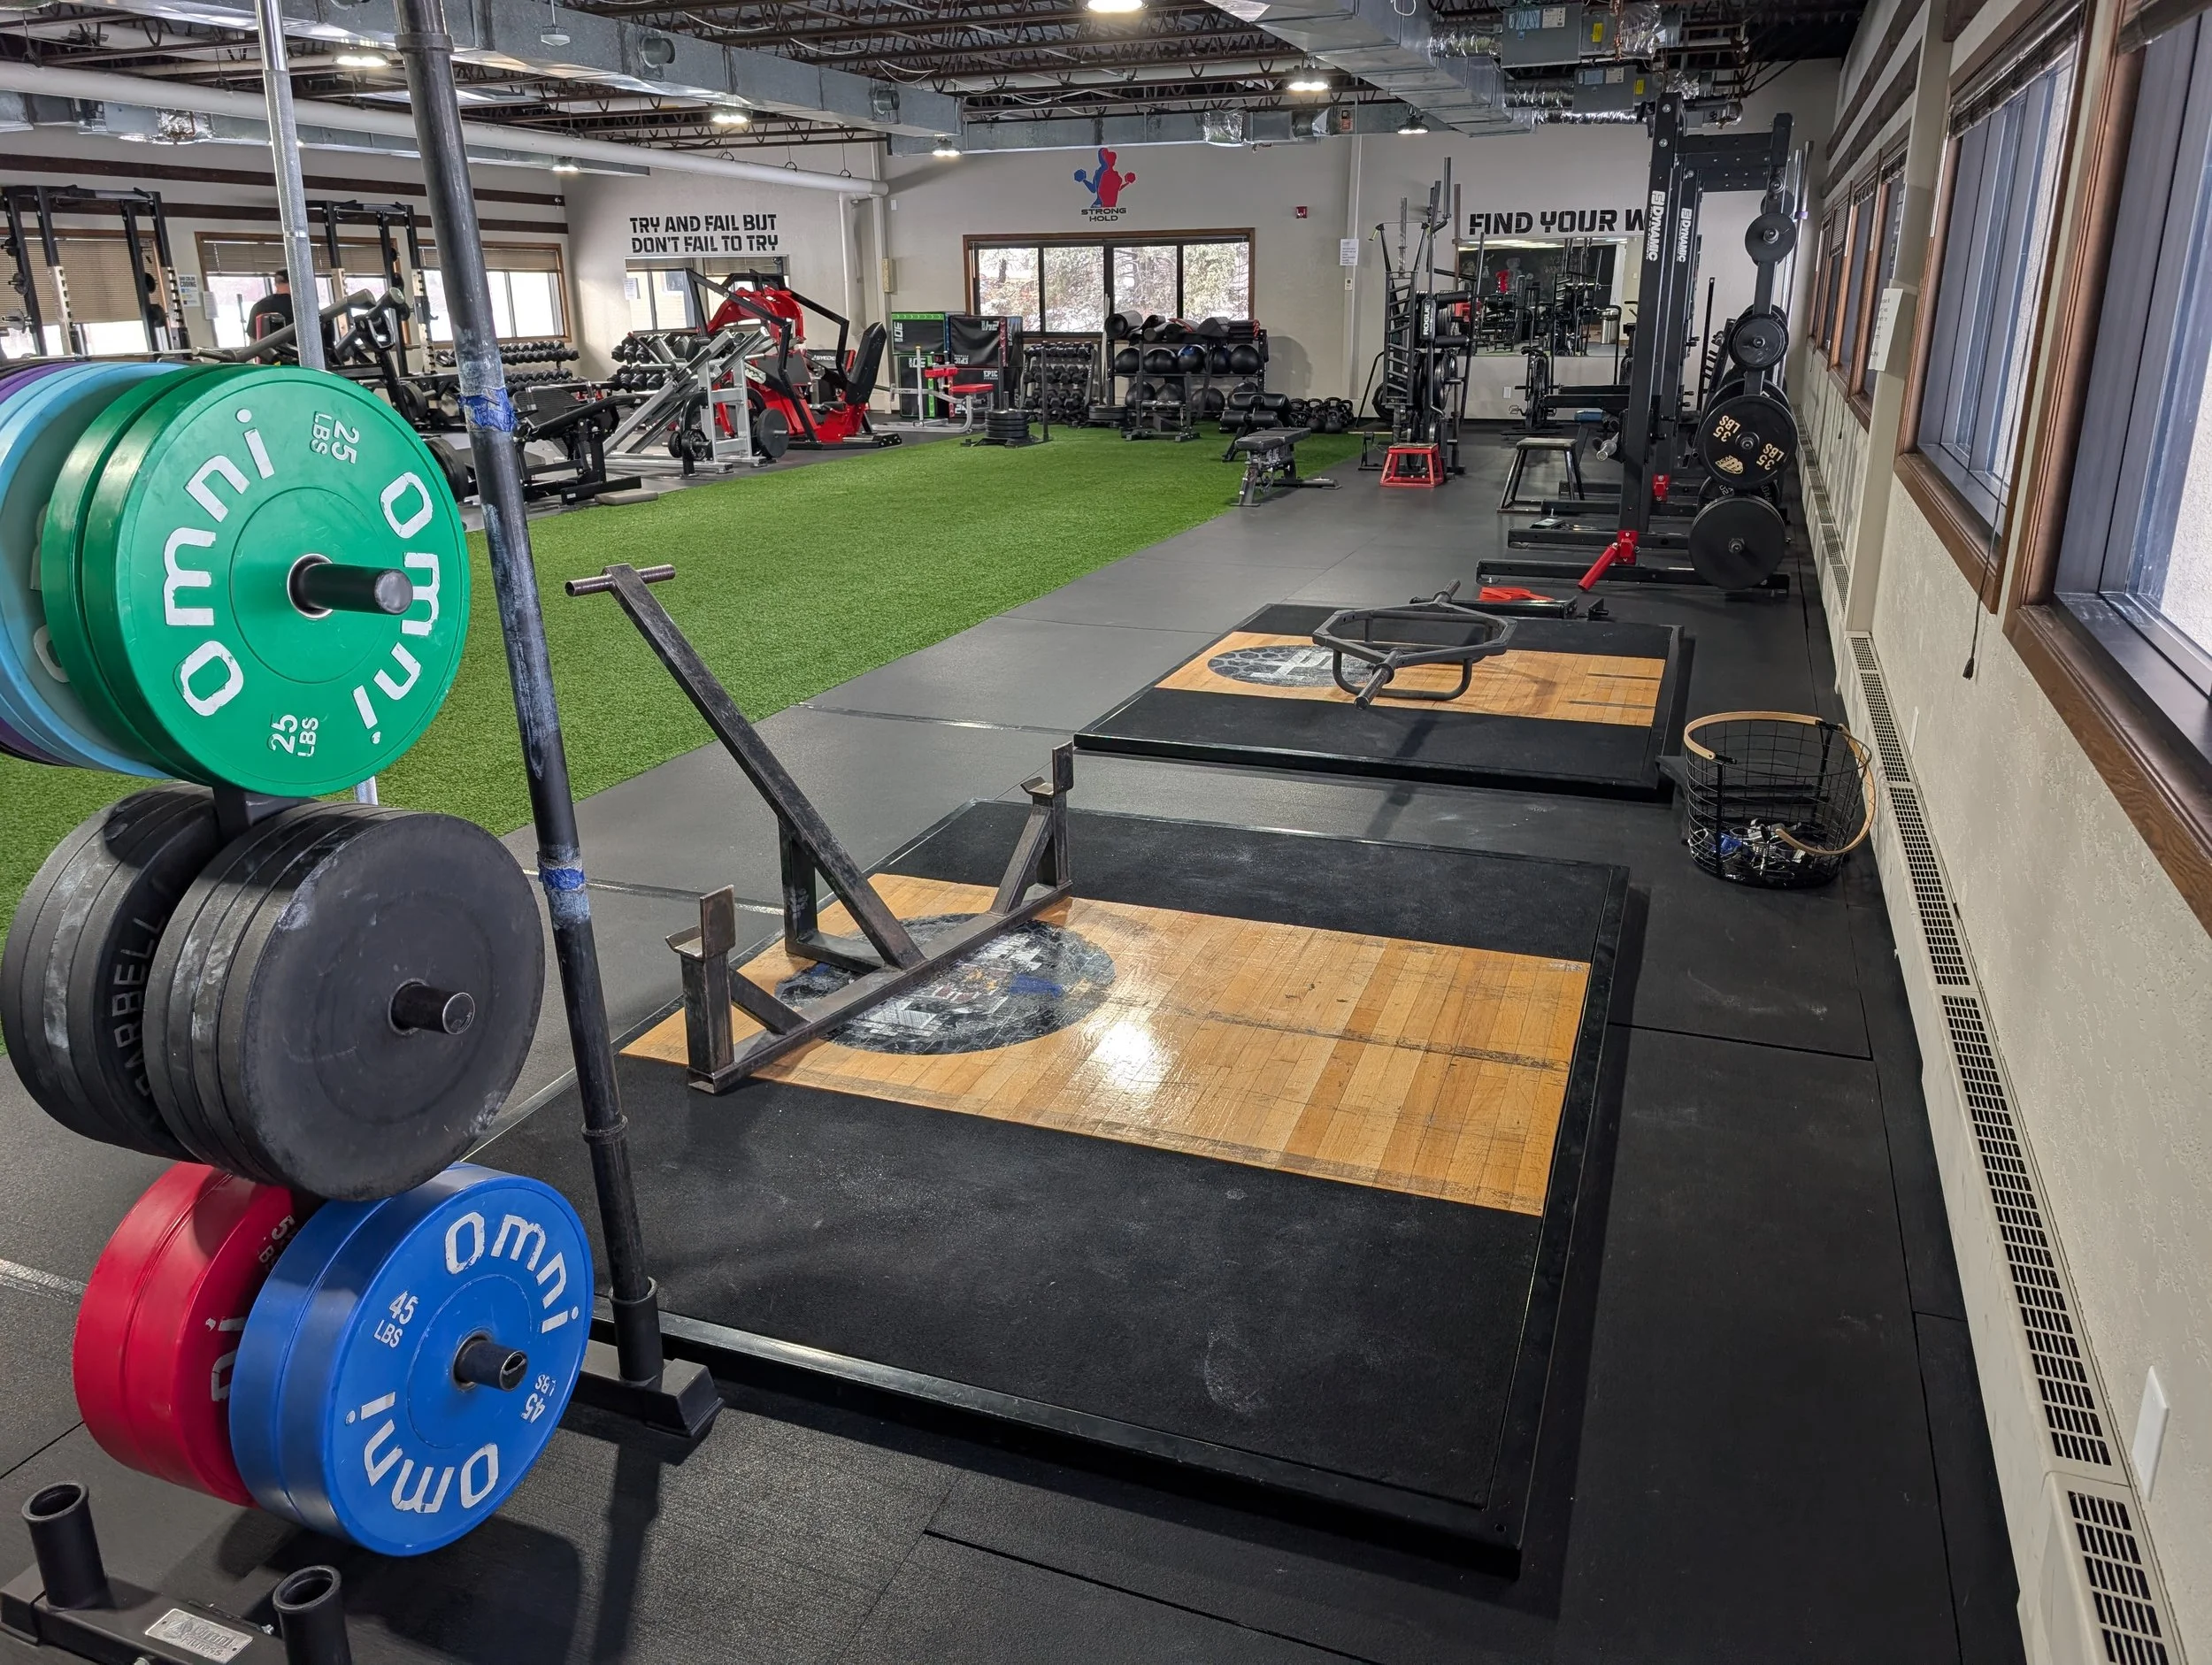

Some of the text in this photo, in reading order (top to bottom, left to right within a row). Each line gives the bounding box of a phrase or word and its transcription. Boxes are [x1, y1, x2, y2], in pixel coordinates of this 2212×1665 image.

[629, 214, 777, 234] TRY AND FAIL BUT
[1469, 211, 1533, 235] FIND
[1540, 210, 1617, 233] YOUR
[1648, 205, 1664, 262] DYNAMIC
[632, 234, 779, 253] DON'T FAIL TO TRY
[1678, 219, 1692, 263] DYNAMIC
[310, 411, 333, 455] LBS
[1713, 426, 1732, 442] 35
[1719, 415, 1741, 434] LBS
[331, 420, 360, 464] 25
[1763, 443, 1785, 462] LBS
[1756, 454, 1775, 471] 35
[163, 408, 275, 717] omni
[267, 714, 298, 754] 25
[297, 717, 319, 756] LBS
[388, 1289, 420, 1325] 45
[373, 1319, 403, 1348] LBS
[534, 1373, 557, 1397] LBS
[520, 1393, 546, 1423] 45
